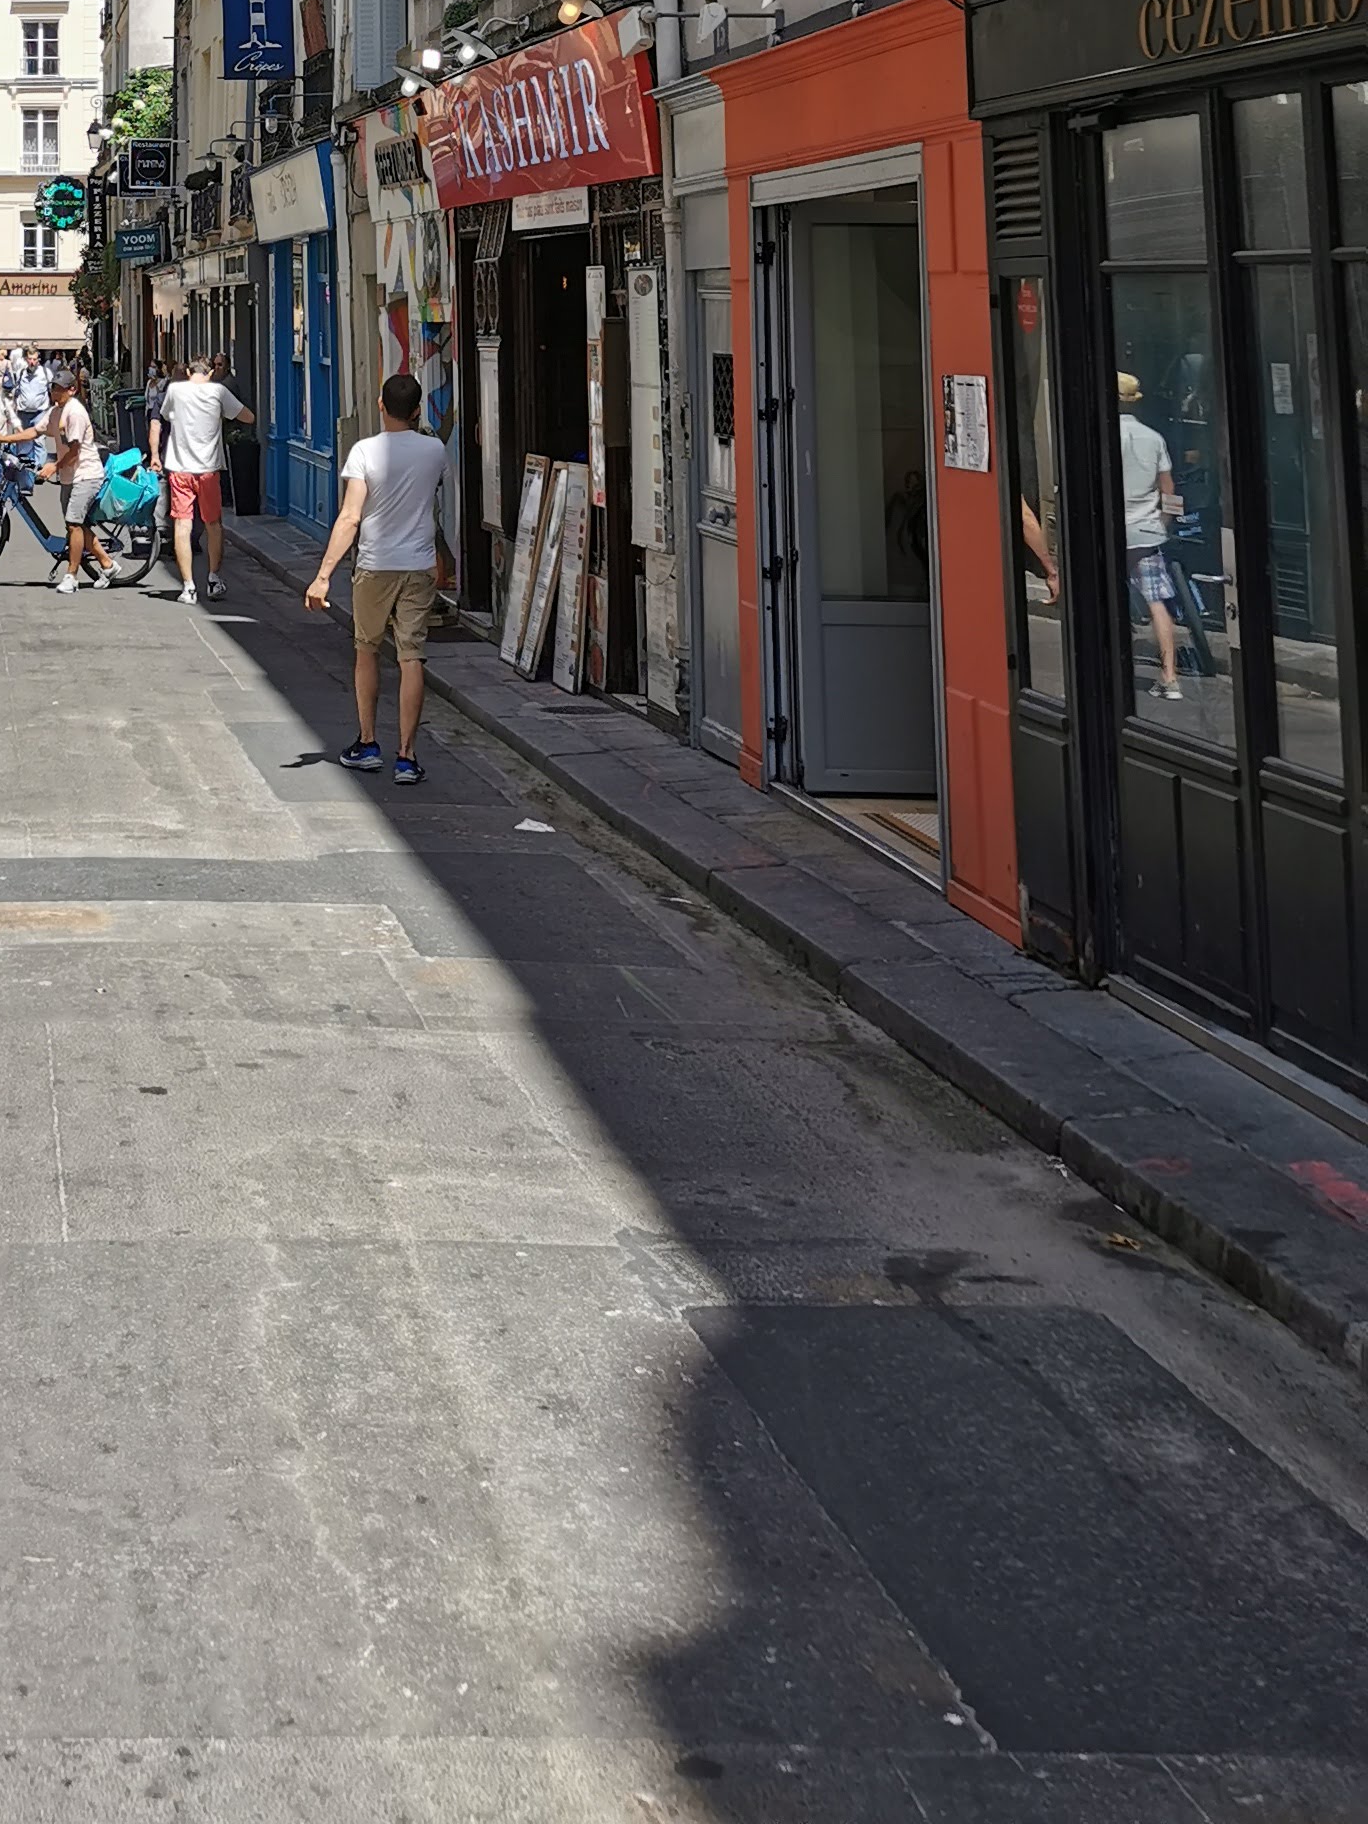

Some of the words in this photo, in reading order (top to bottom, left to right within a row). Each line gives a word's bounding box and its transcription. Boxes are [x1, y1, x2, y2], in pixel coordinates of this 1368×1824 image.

[234, 50, 284, 76] Crêpes
[454, 58, 610, 178] KASHMIR
[93, 188, 104, 248] PIZZERIA
[122, 233, 155, 245] YOOM
